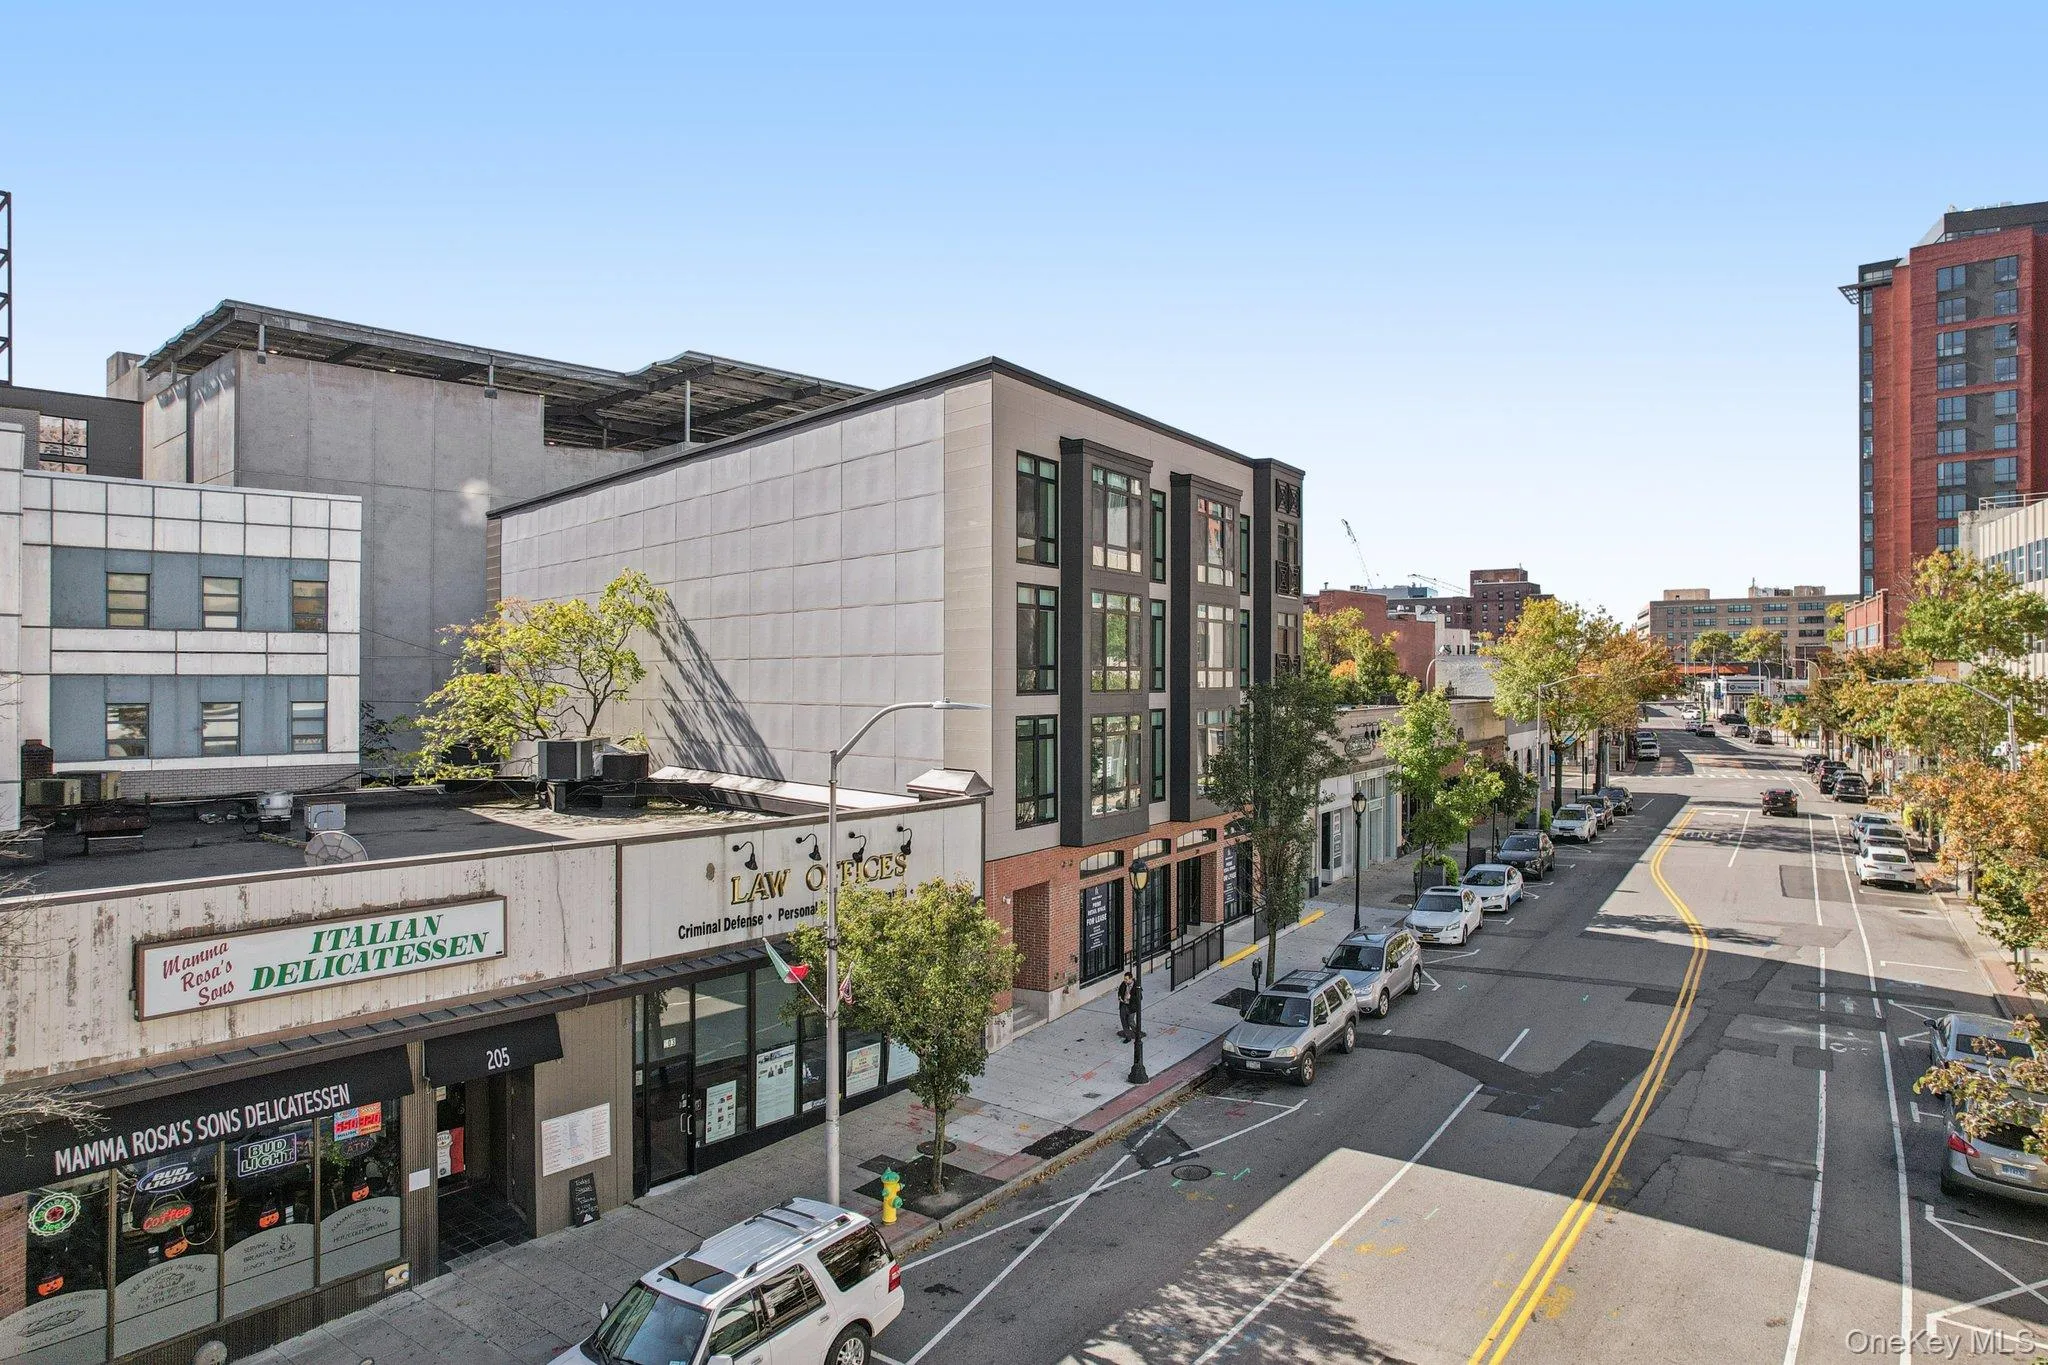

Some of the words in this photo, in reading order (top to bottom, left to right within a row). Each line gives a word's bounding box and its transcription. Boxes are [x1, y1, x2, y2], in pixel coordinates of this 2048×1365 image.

[731, 868, 790, 905] LAW
[805, 852, 907, 892] OFICES
[678, 915, 721, 940] Criminal
[724, 914, 764, 931] Defense
[778, 901, 818, 922] Personal
[1086, 917, 1095, 926] FOR
[1095, 913, 1107, 923] LEASE
[309, 914, 443, 955] ITALIAN
[162, 941, 229, 980] Mamma
[249, 931, 489, 992] DELICATESSEN
[180, 959, 233, 992] Rosa's
[198, 978, 235, 1006] Sons
[486, 1047, 510, 1070] 205
[55, 1136, 128, 1176] MAMMA
[132, 1119, 193, 1157] ROSA'S
[197, 1108, 241, 1140] SONS
[244, 1083, 351, 1128] DELICATESSEN
[249, 1139, 287, 1158] BUD
[347, 1141, 370, 1153] ATM
[153, 1166, 188, 1182] BUD
[241, 1150, 295, 1173] LIGHT
[144, 1171, 194, 1191] LIGHT
[143, 1203, 193, 1231] Coffee
[243, 1248, 276, 1262] BREAKFAST
